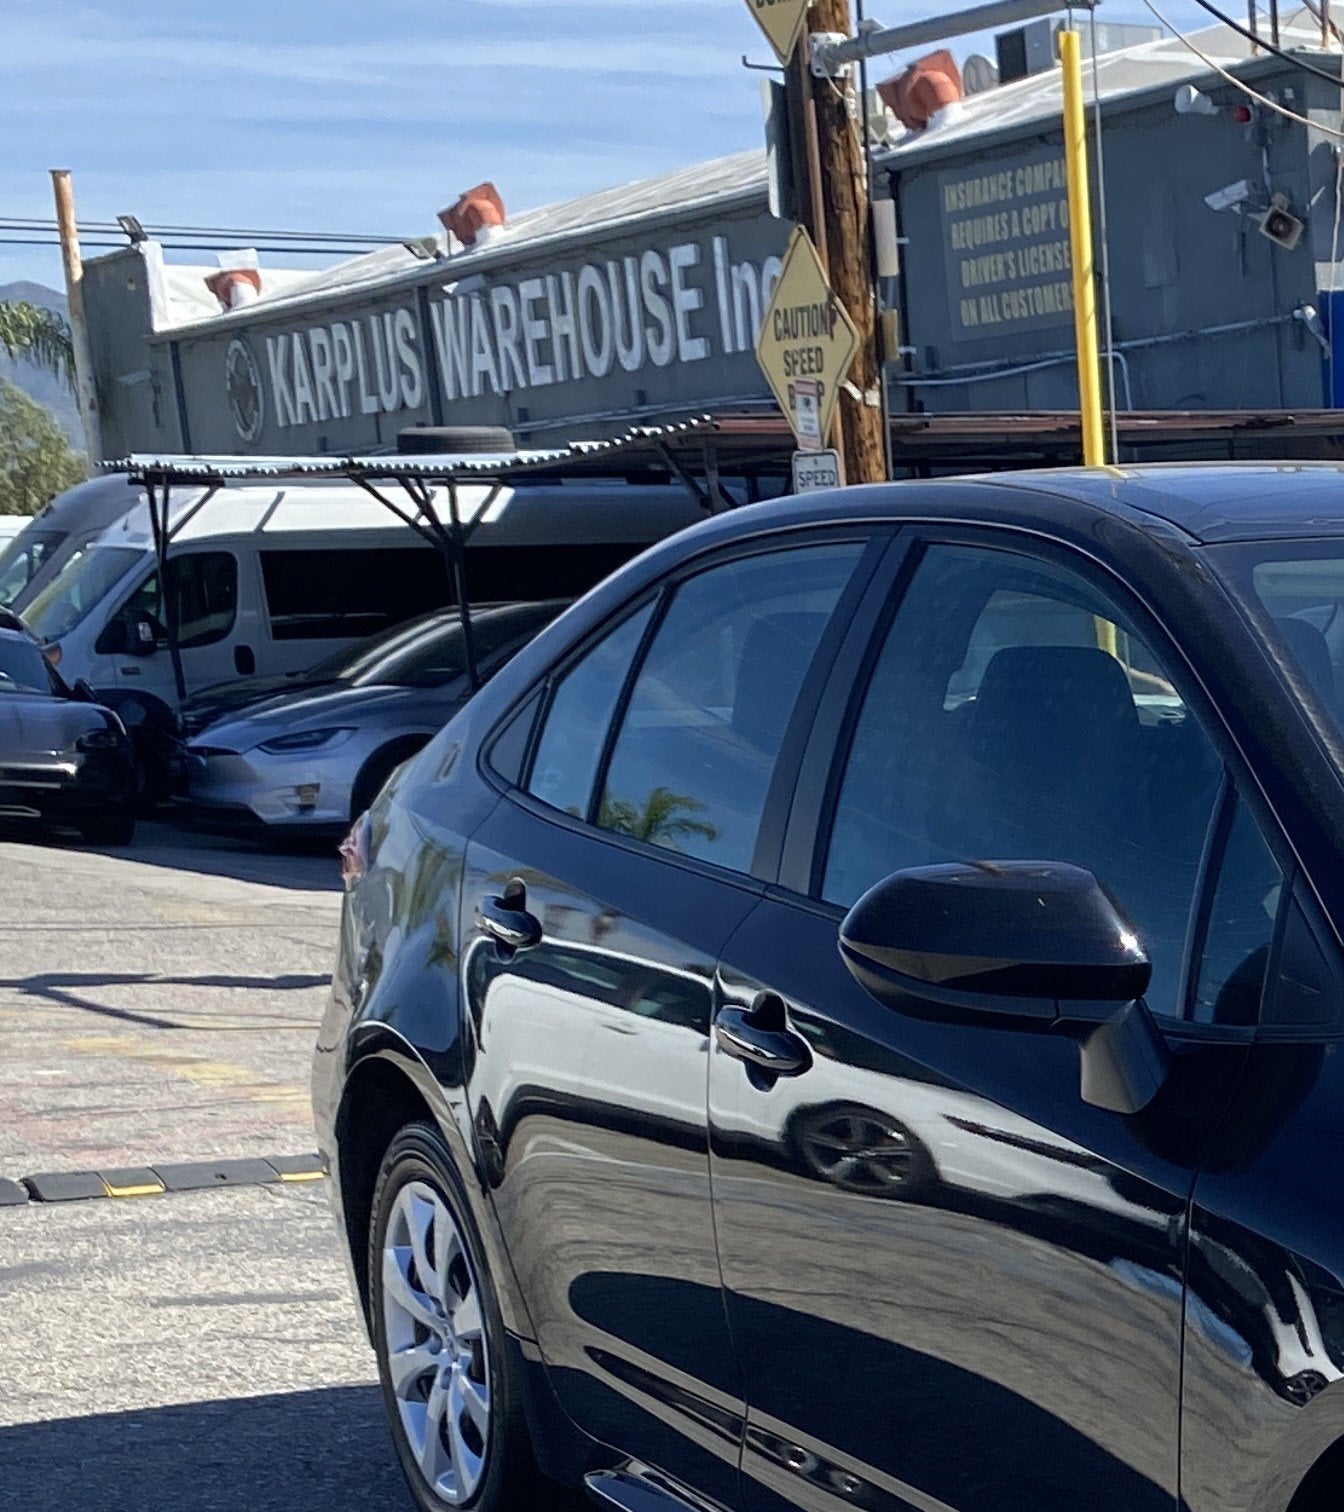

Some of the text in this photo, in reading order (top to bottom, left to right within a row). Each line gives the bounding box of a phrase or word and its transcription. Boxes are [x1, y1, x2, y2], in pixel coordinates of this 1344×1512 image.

[945, 159, 1067, 212] INSURANCE COMPA
[952, 199, 1069, 250] REQUIRES A COPY O
[961, 251, 1016, 288] DRIVER'S
[960, 282, 1074, 327] ON ALL CUSTOMER
[266, 308, 422, 428] KARPLUS
[430, 244, 710, 401] WAREHOUSE
[783, 346, 823, 377] SPEED
[798, 470, 836, 487] SPEED
